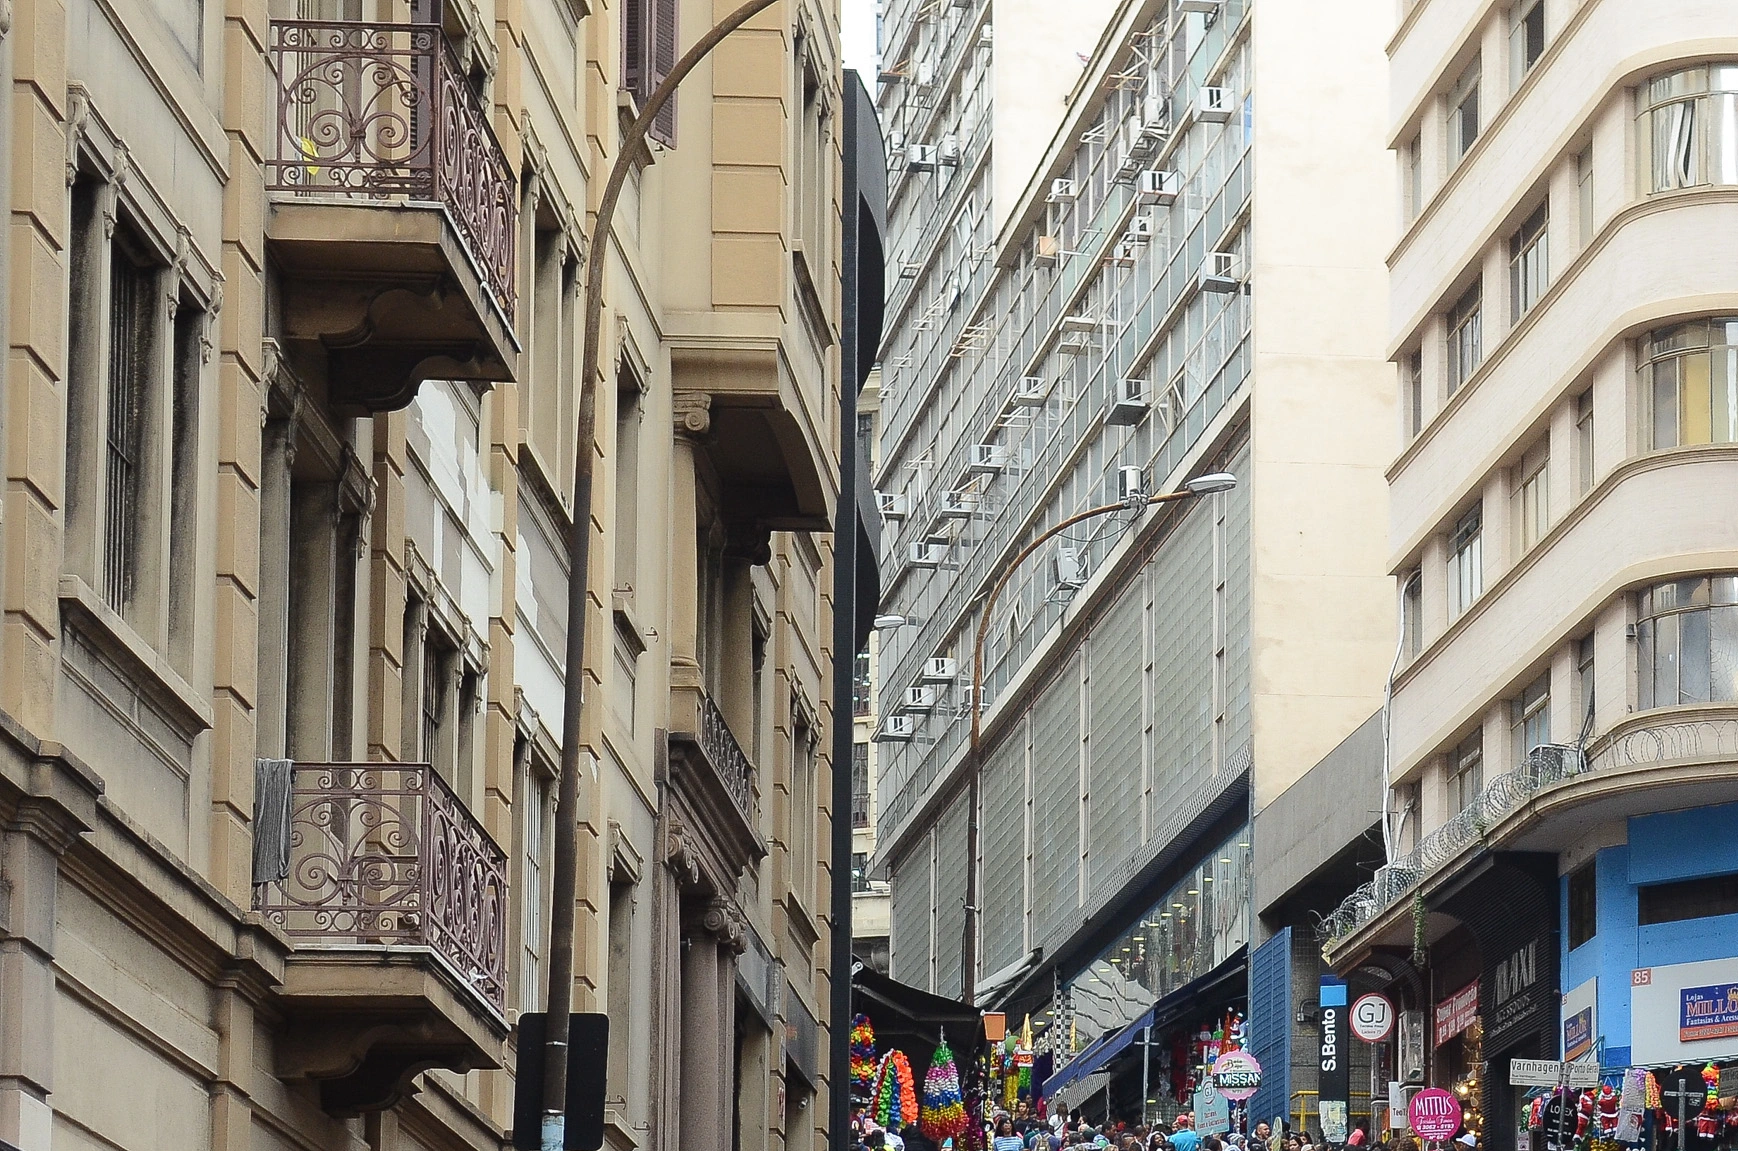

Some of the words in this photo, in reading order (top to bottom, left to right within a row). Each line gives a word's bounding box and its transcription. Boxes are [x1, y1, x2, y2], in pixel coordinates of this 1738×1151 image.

[1634, 971, 1648, 984] 85
[1686, 993, 1703, 1001] Lojas
[1358, 1003, 1386, 1024] GJ
[1322, 1008, 1336, 1072] S.Bento
[1511, 1061, 1559, 1075] Varnhagen
[1415, 1096, 1453, 1116] MITTUS
